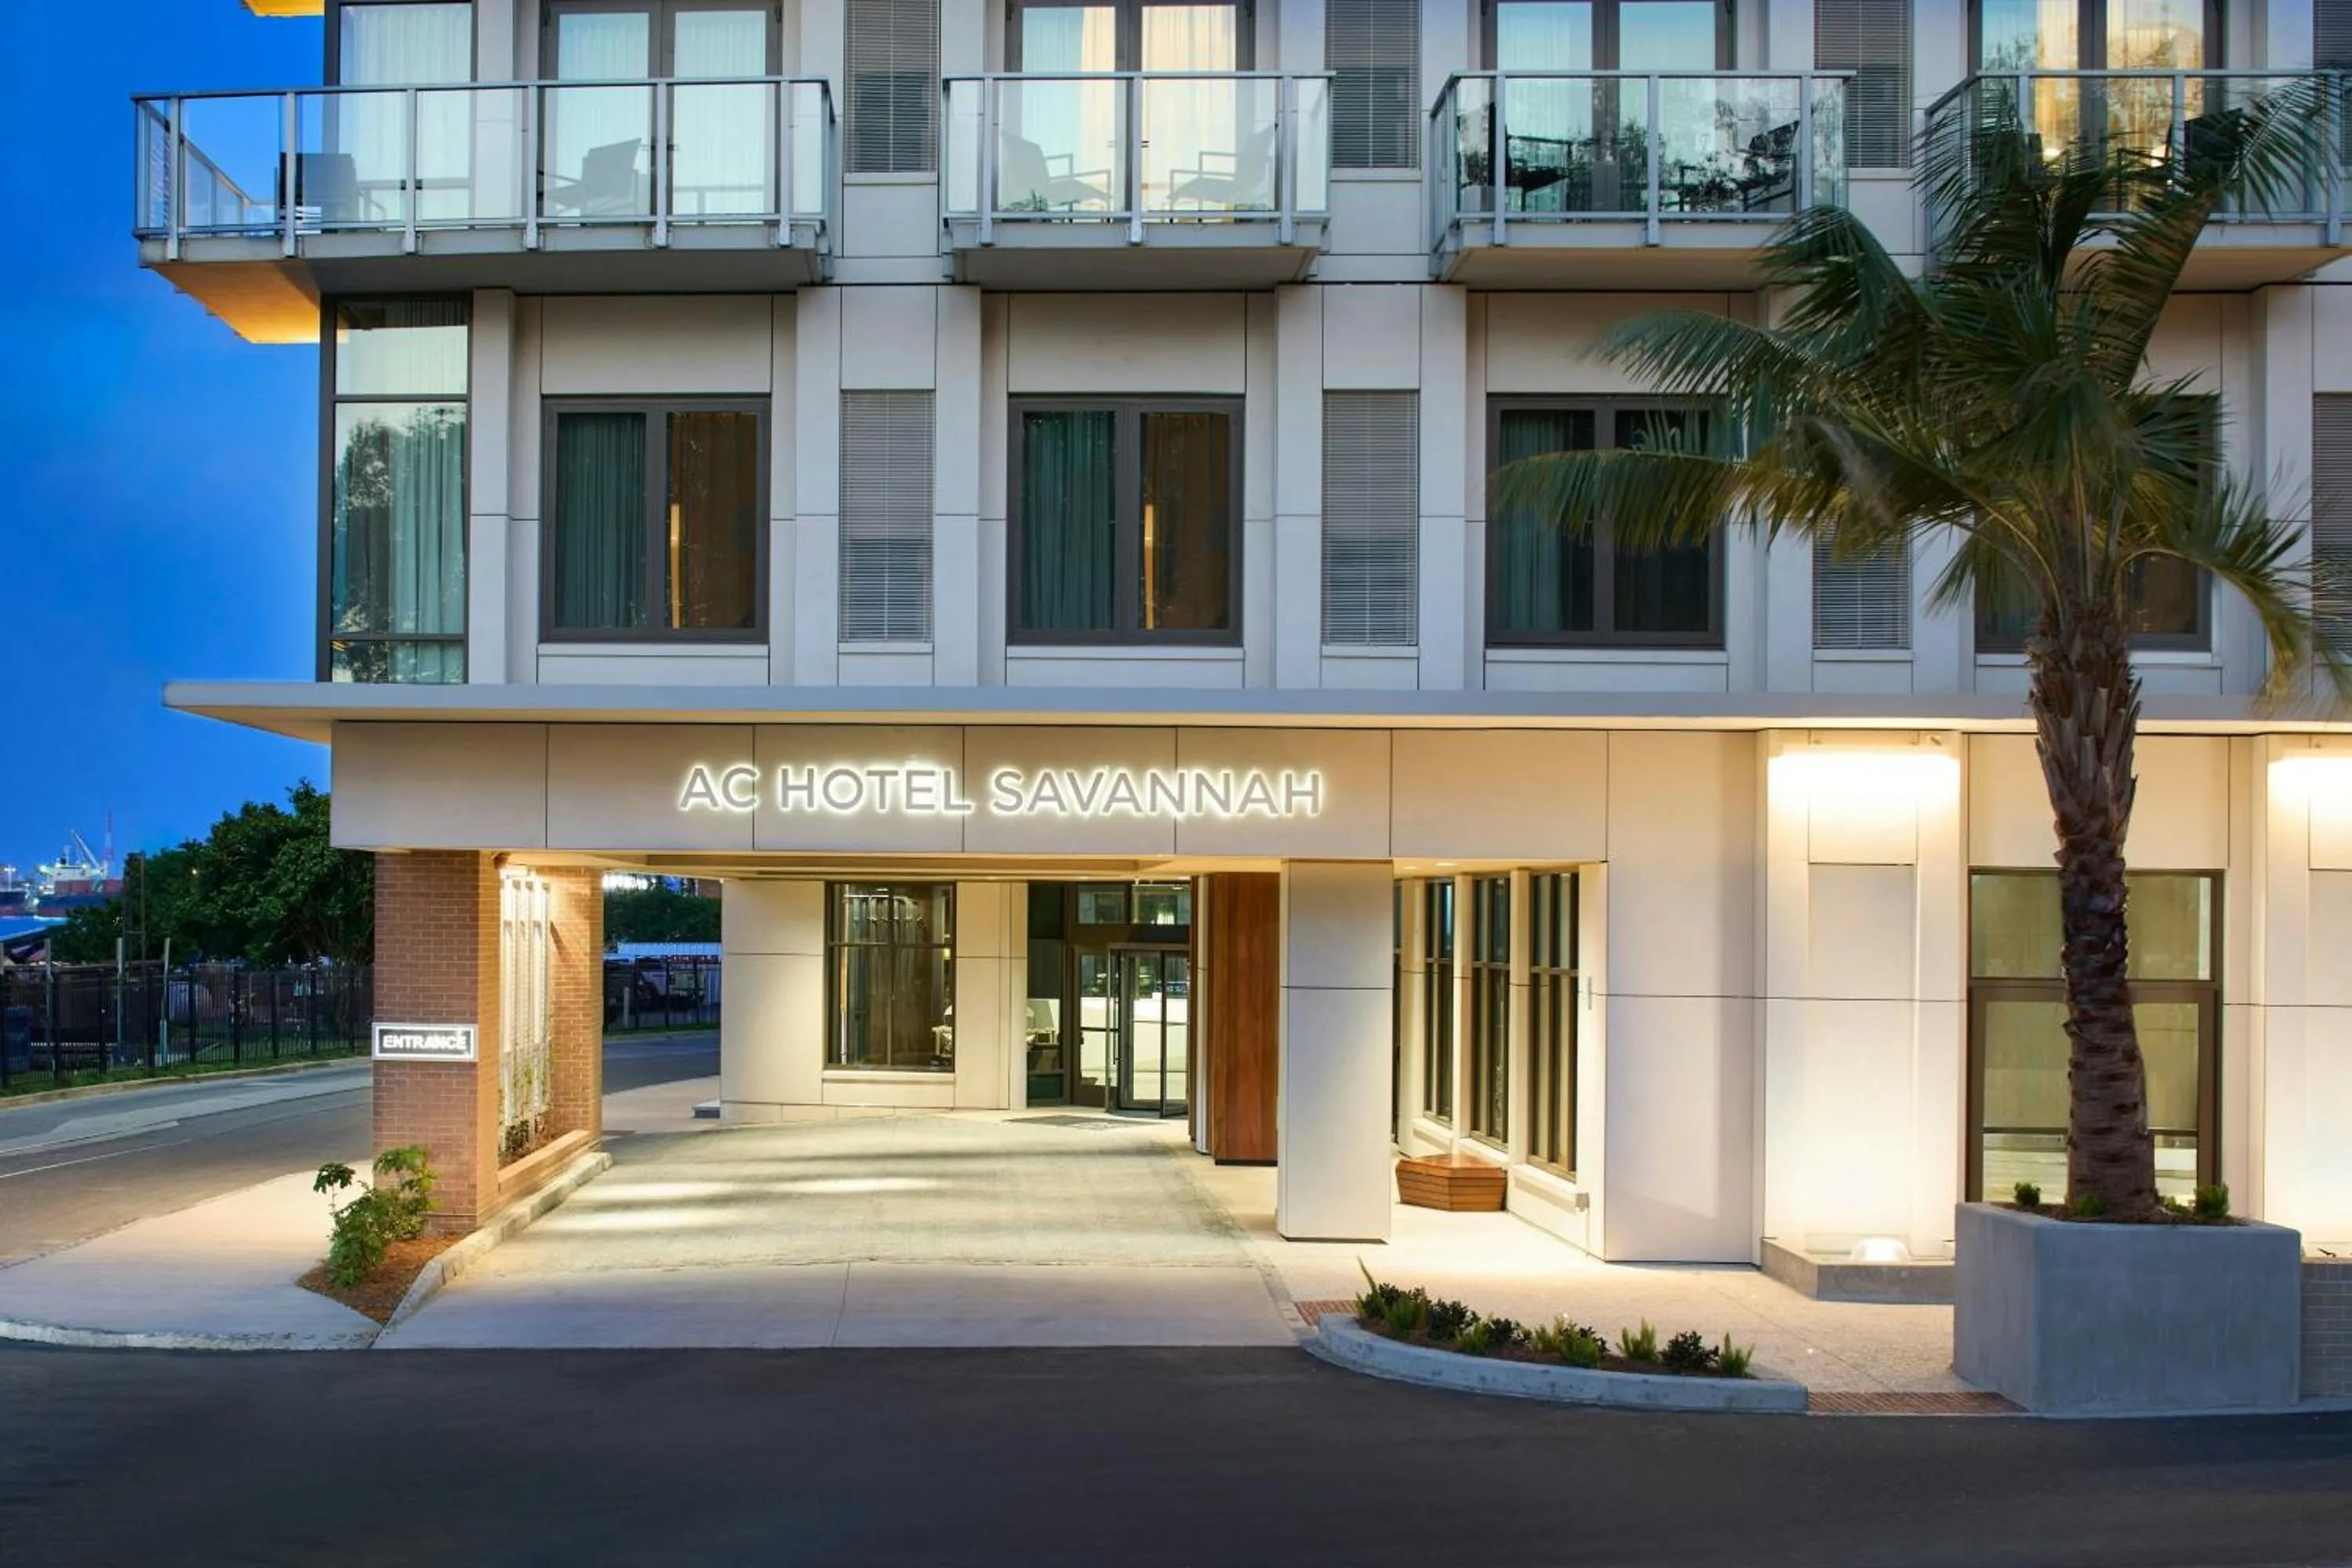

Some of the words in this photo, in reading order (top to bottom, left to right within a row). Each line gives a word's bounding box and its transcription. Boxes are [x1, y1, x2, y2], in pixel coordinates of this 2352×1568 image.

[680, 766, 757, 809] AC
[780, 768, 972, 811] HOTEL
[993, 771, 1320, 815] SAVANNAH
[382, 1034, 467, 1050] ENTRANCE
